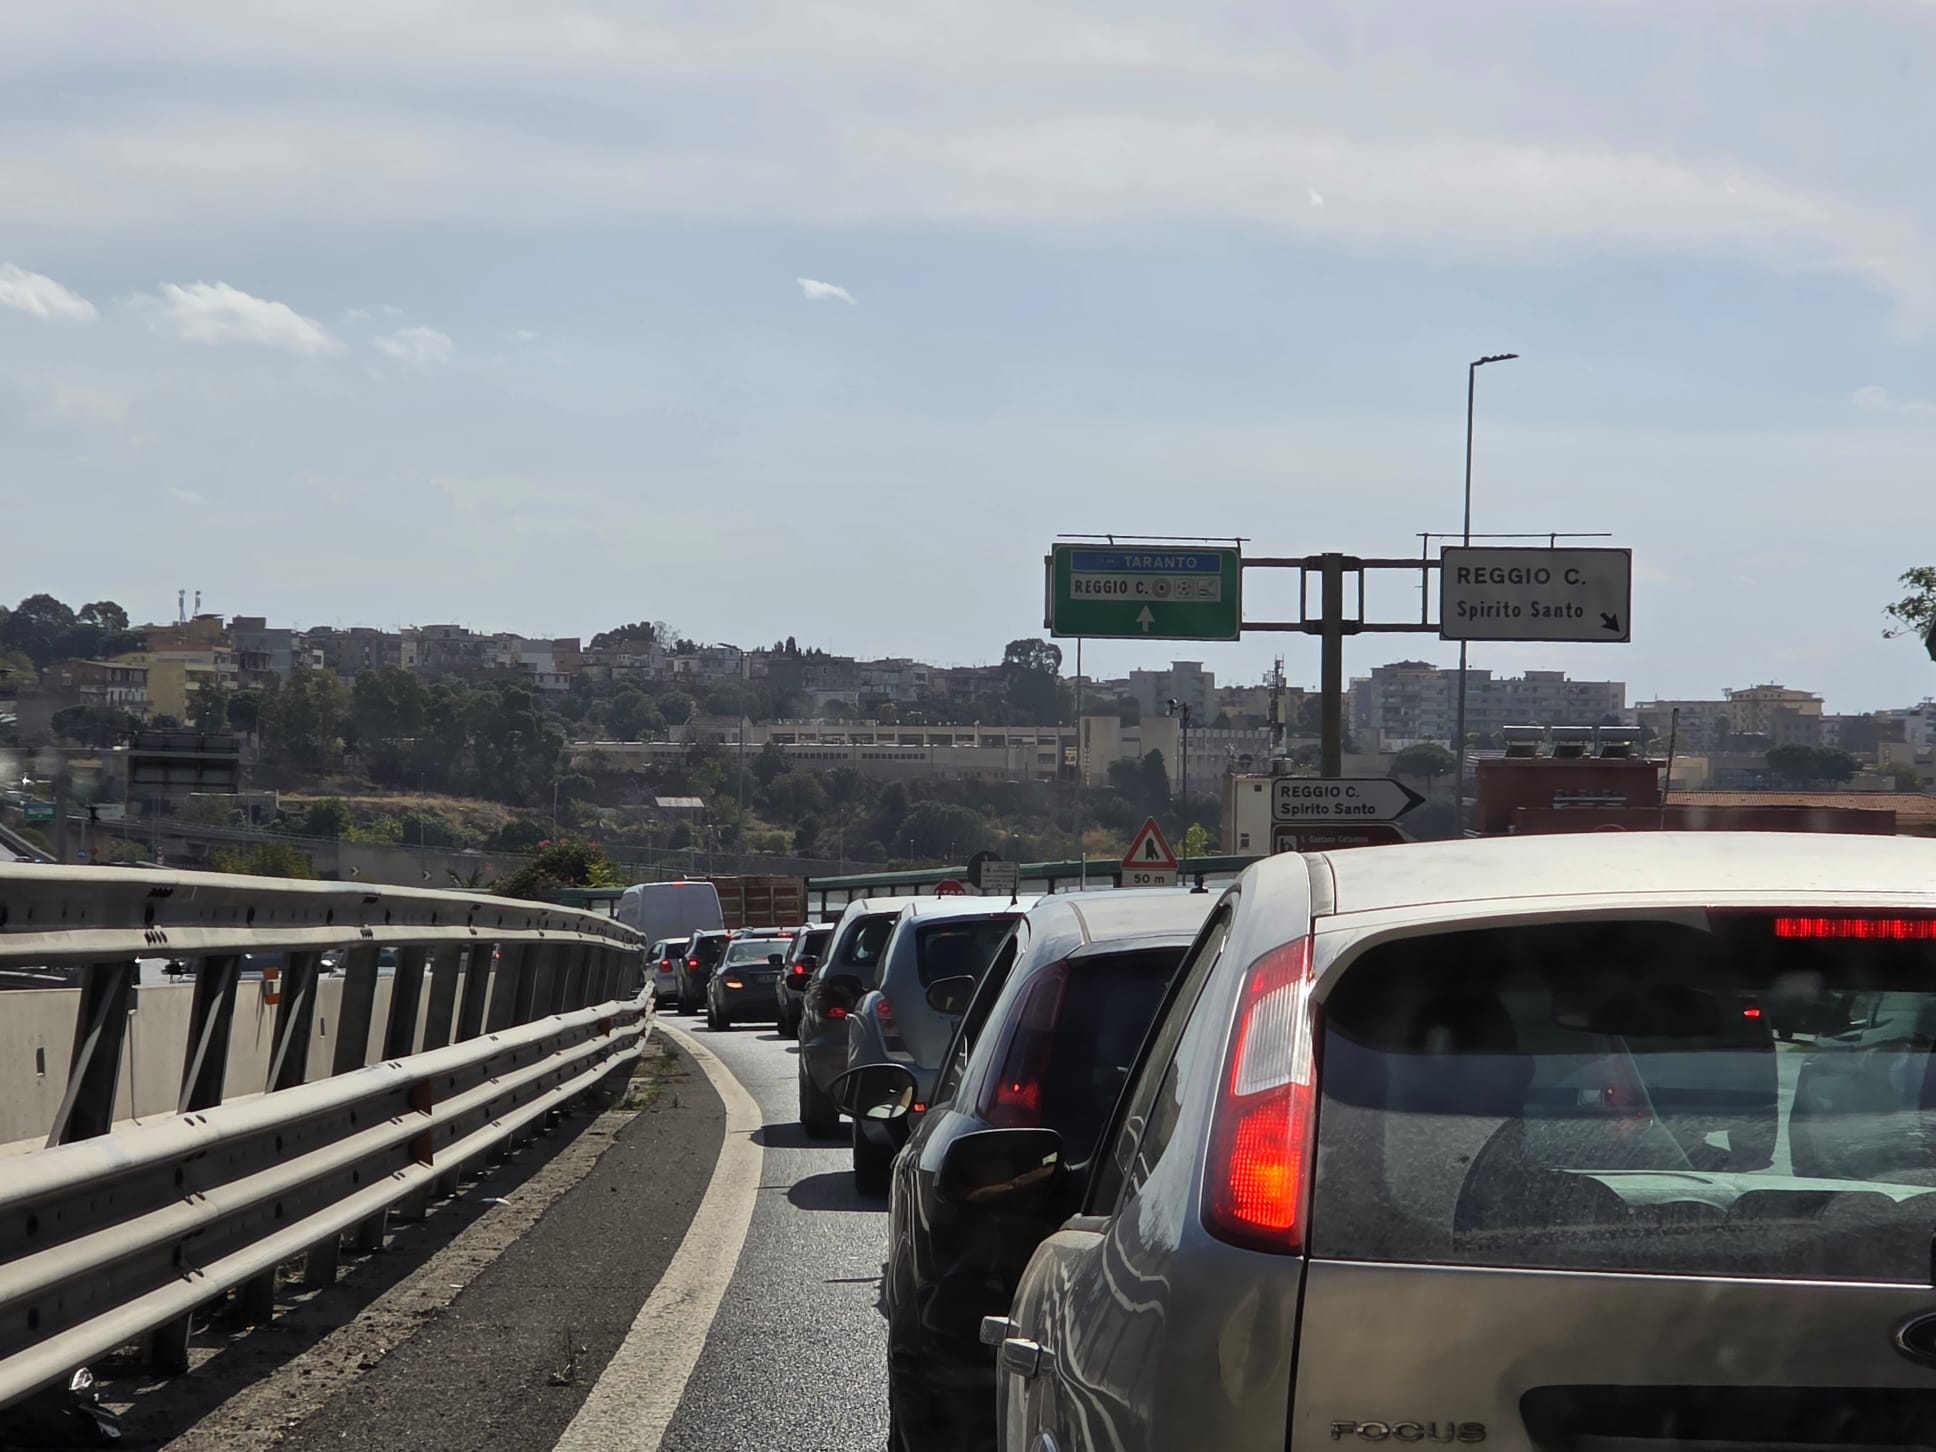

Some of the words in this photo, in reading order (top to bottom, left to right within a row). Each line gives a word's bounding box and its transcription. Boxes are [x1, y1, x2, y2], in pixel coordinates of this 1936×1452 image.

[1123, 555, 1198, 569] TARANTO
[1456, 567, 1551, 585] REGGIO
[1564, 568, 1586, 585] C.
[1074, 579, 1128, 594] REGGIO
[1135, 580, 1149, 595] C.
[1456, 600, 1522, 621] Spirito
[1530, 601, 1584, 618] Santo
[1280, 785, 1341, 798] REGGIO
[1345, 786, 1360, 798] C.
[1280, 803, 1330, 816] Spirito
[1334, 803, 1376, 815] Santo
[1133, 873, 1150, 884] 50
[1153, 875, 1165, 884] m
[1330, 1419, 1487, 1444] FOCUS
